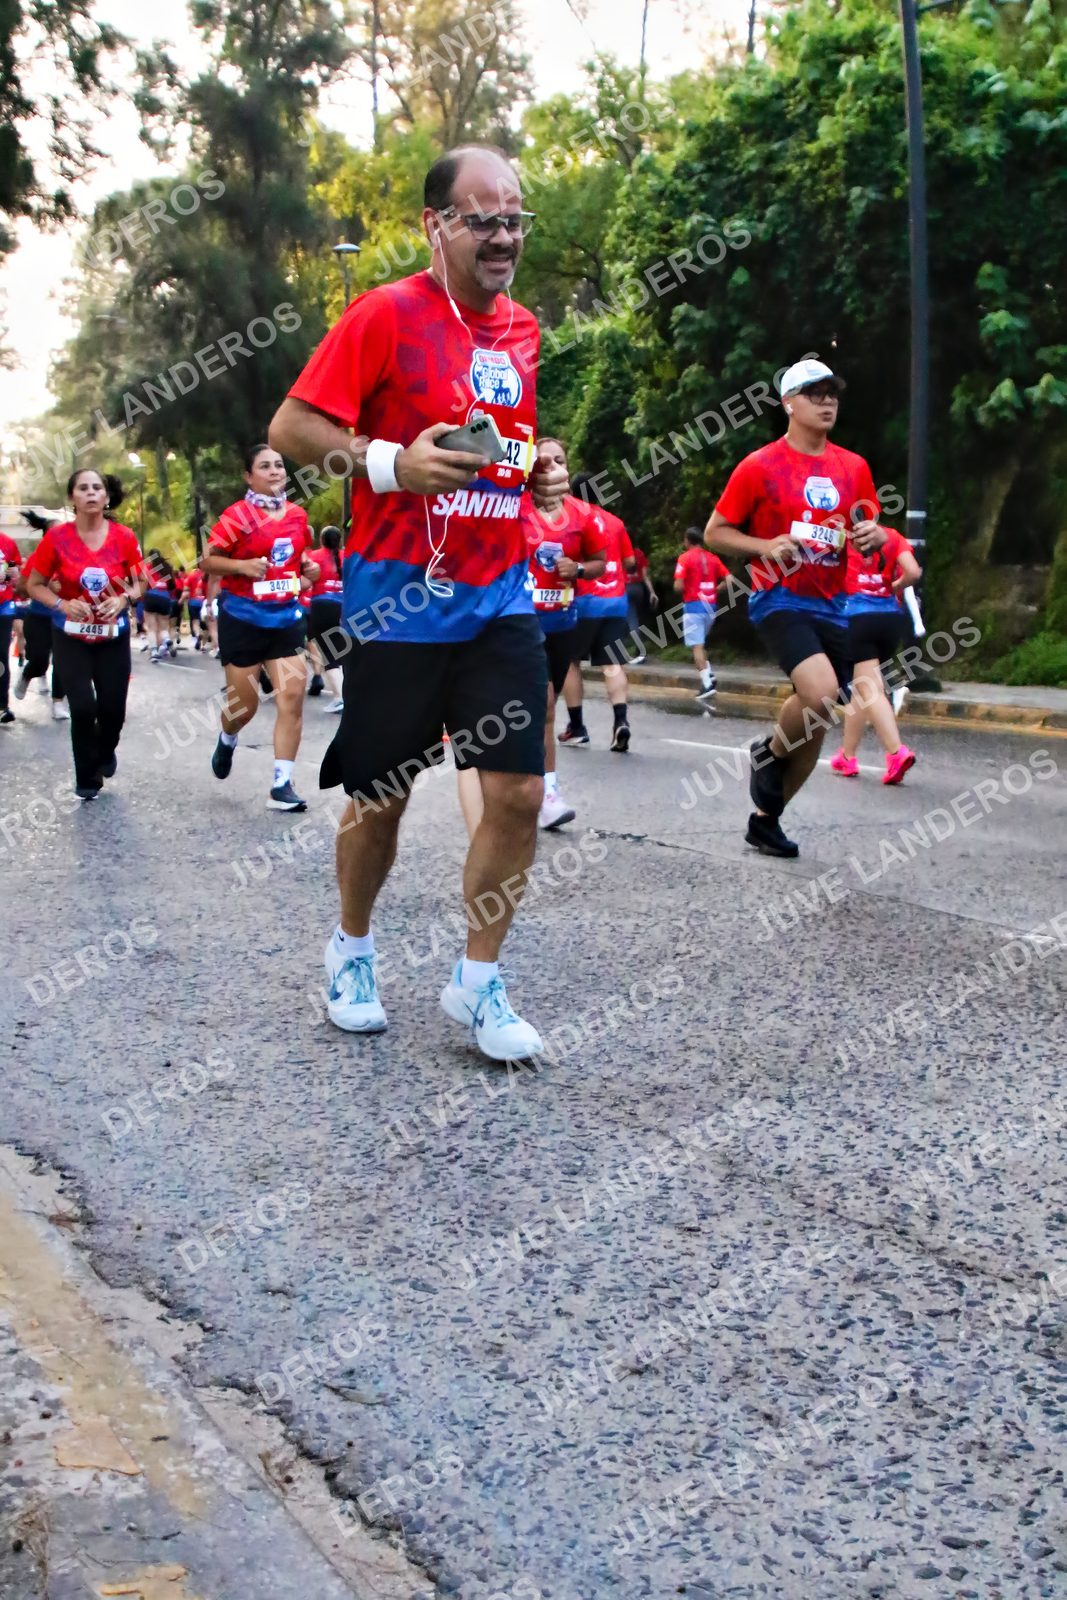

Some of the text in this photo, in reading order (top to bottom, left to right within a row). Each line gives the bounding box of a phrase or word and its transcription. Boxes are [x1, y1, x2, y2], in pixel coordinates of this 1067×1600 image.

[499, 441, 521, 465] 42
[432, 489, 520, 518] SANTIAG
[270, 580, 290, 591] 3421
[540, 590, 561, 601] 1222
[80, 624, 103, 634] 2445
